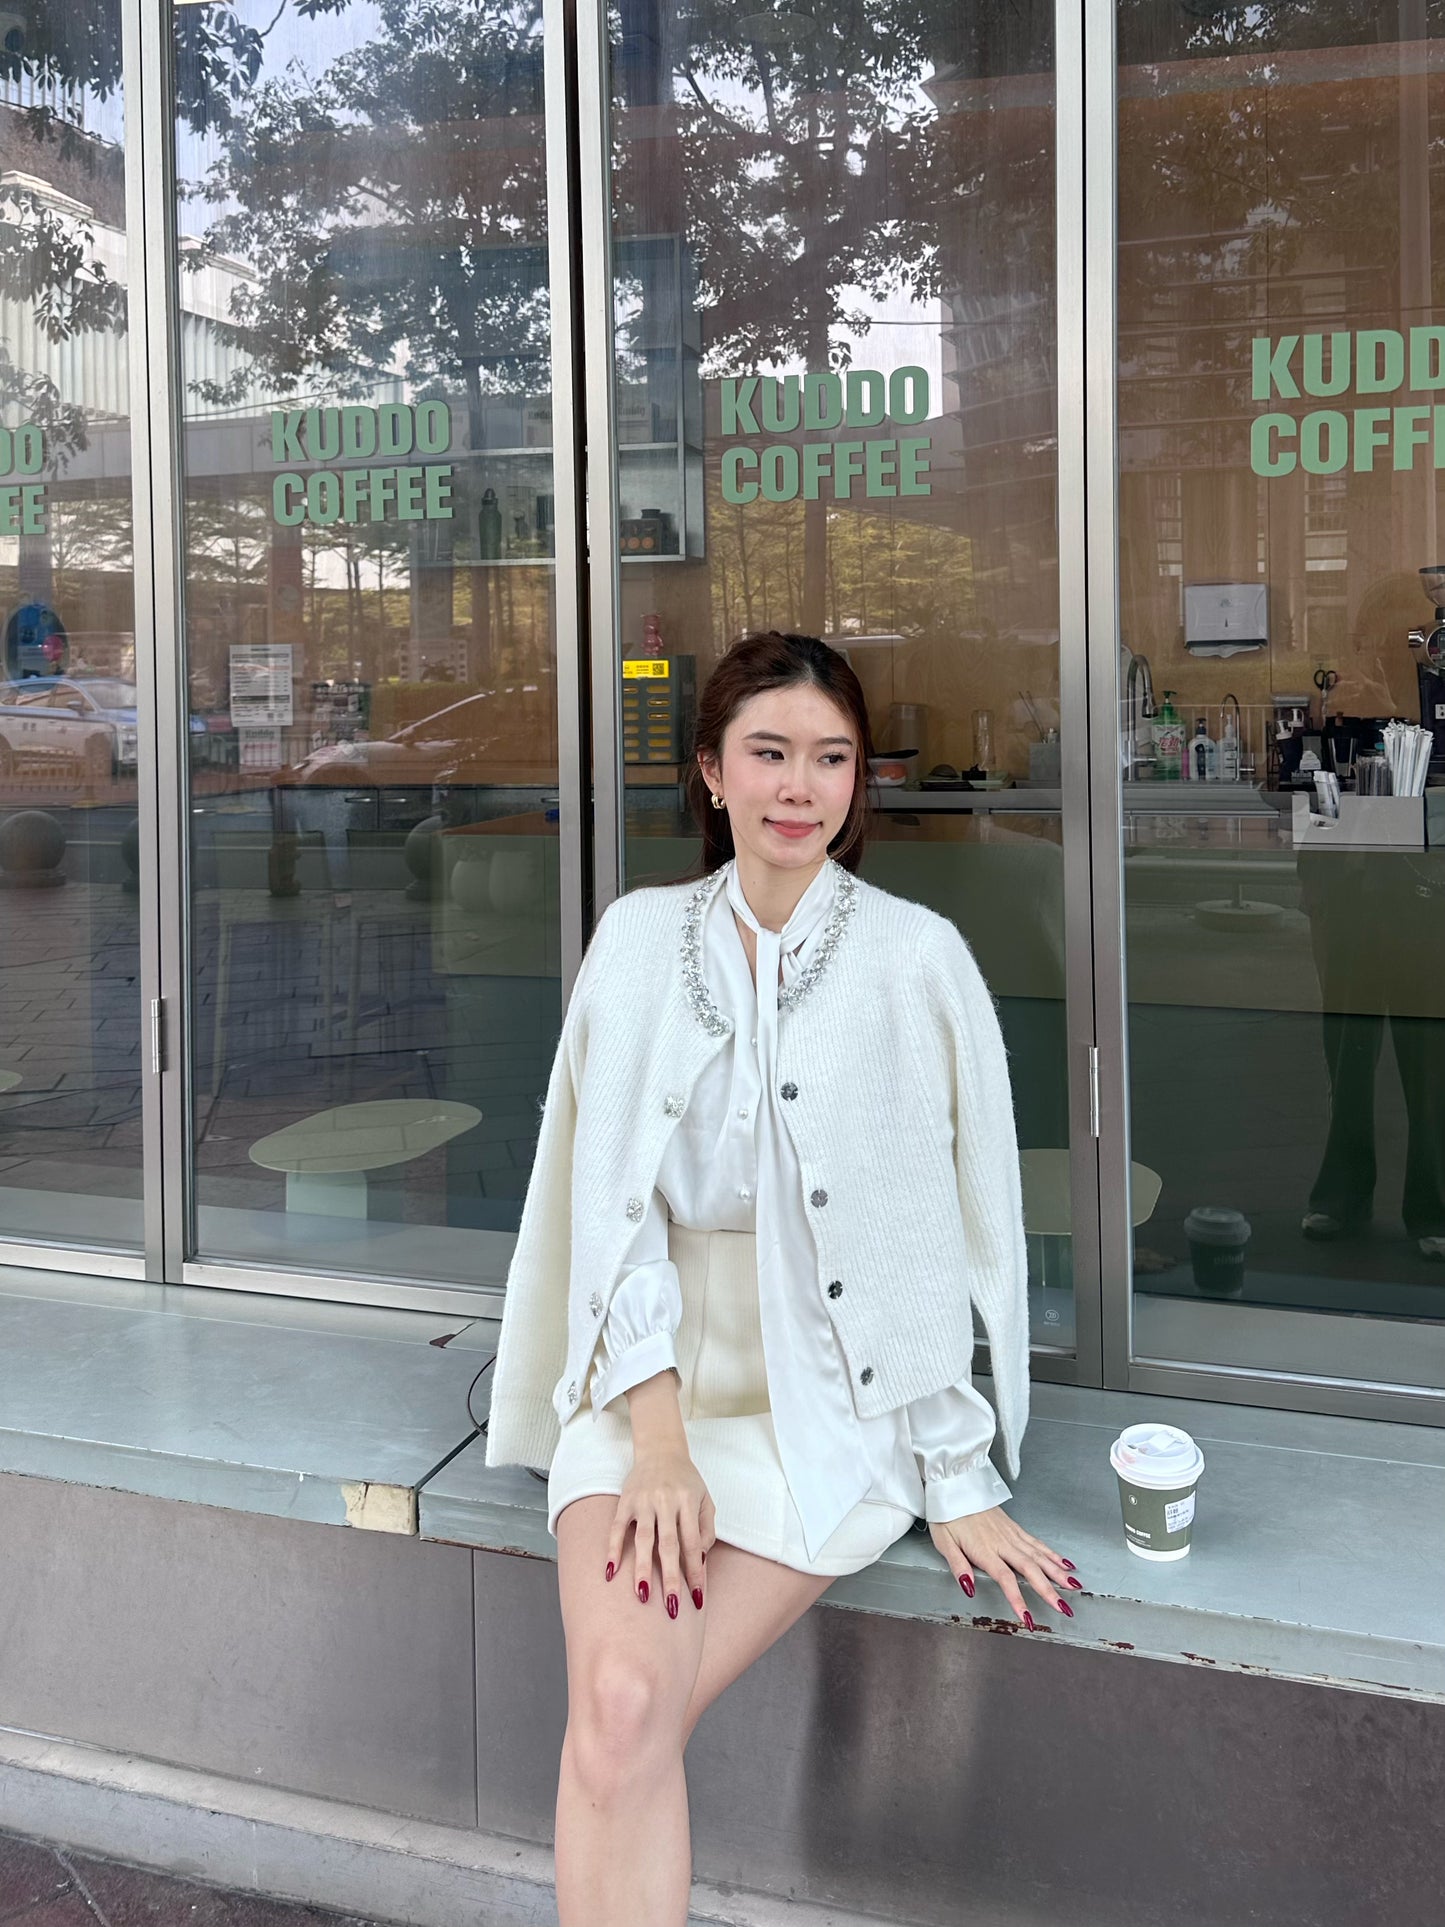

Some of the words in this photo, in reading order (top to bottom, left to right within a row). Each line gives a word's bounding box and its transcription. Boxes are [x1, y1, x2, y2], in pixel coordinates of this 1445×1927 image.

[1252, 326, 1445, 400] KUDD
[272, 399, 452, 462] KUDDO
[721, 366, 930, 435] KUDDO
[272, 465, 454, 526] COFFEE
[721, 437, 931, 504] COFFEE
